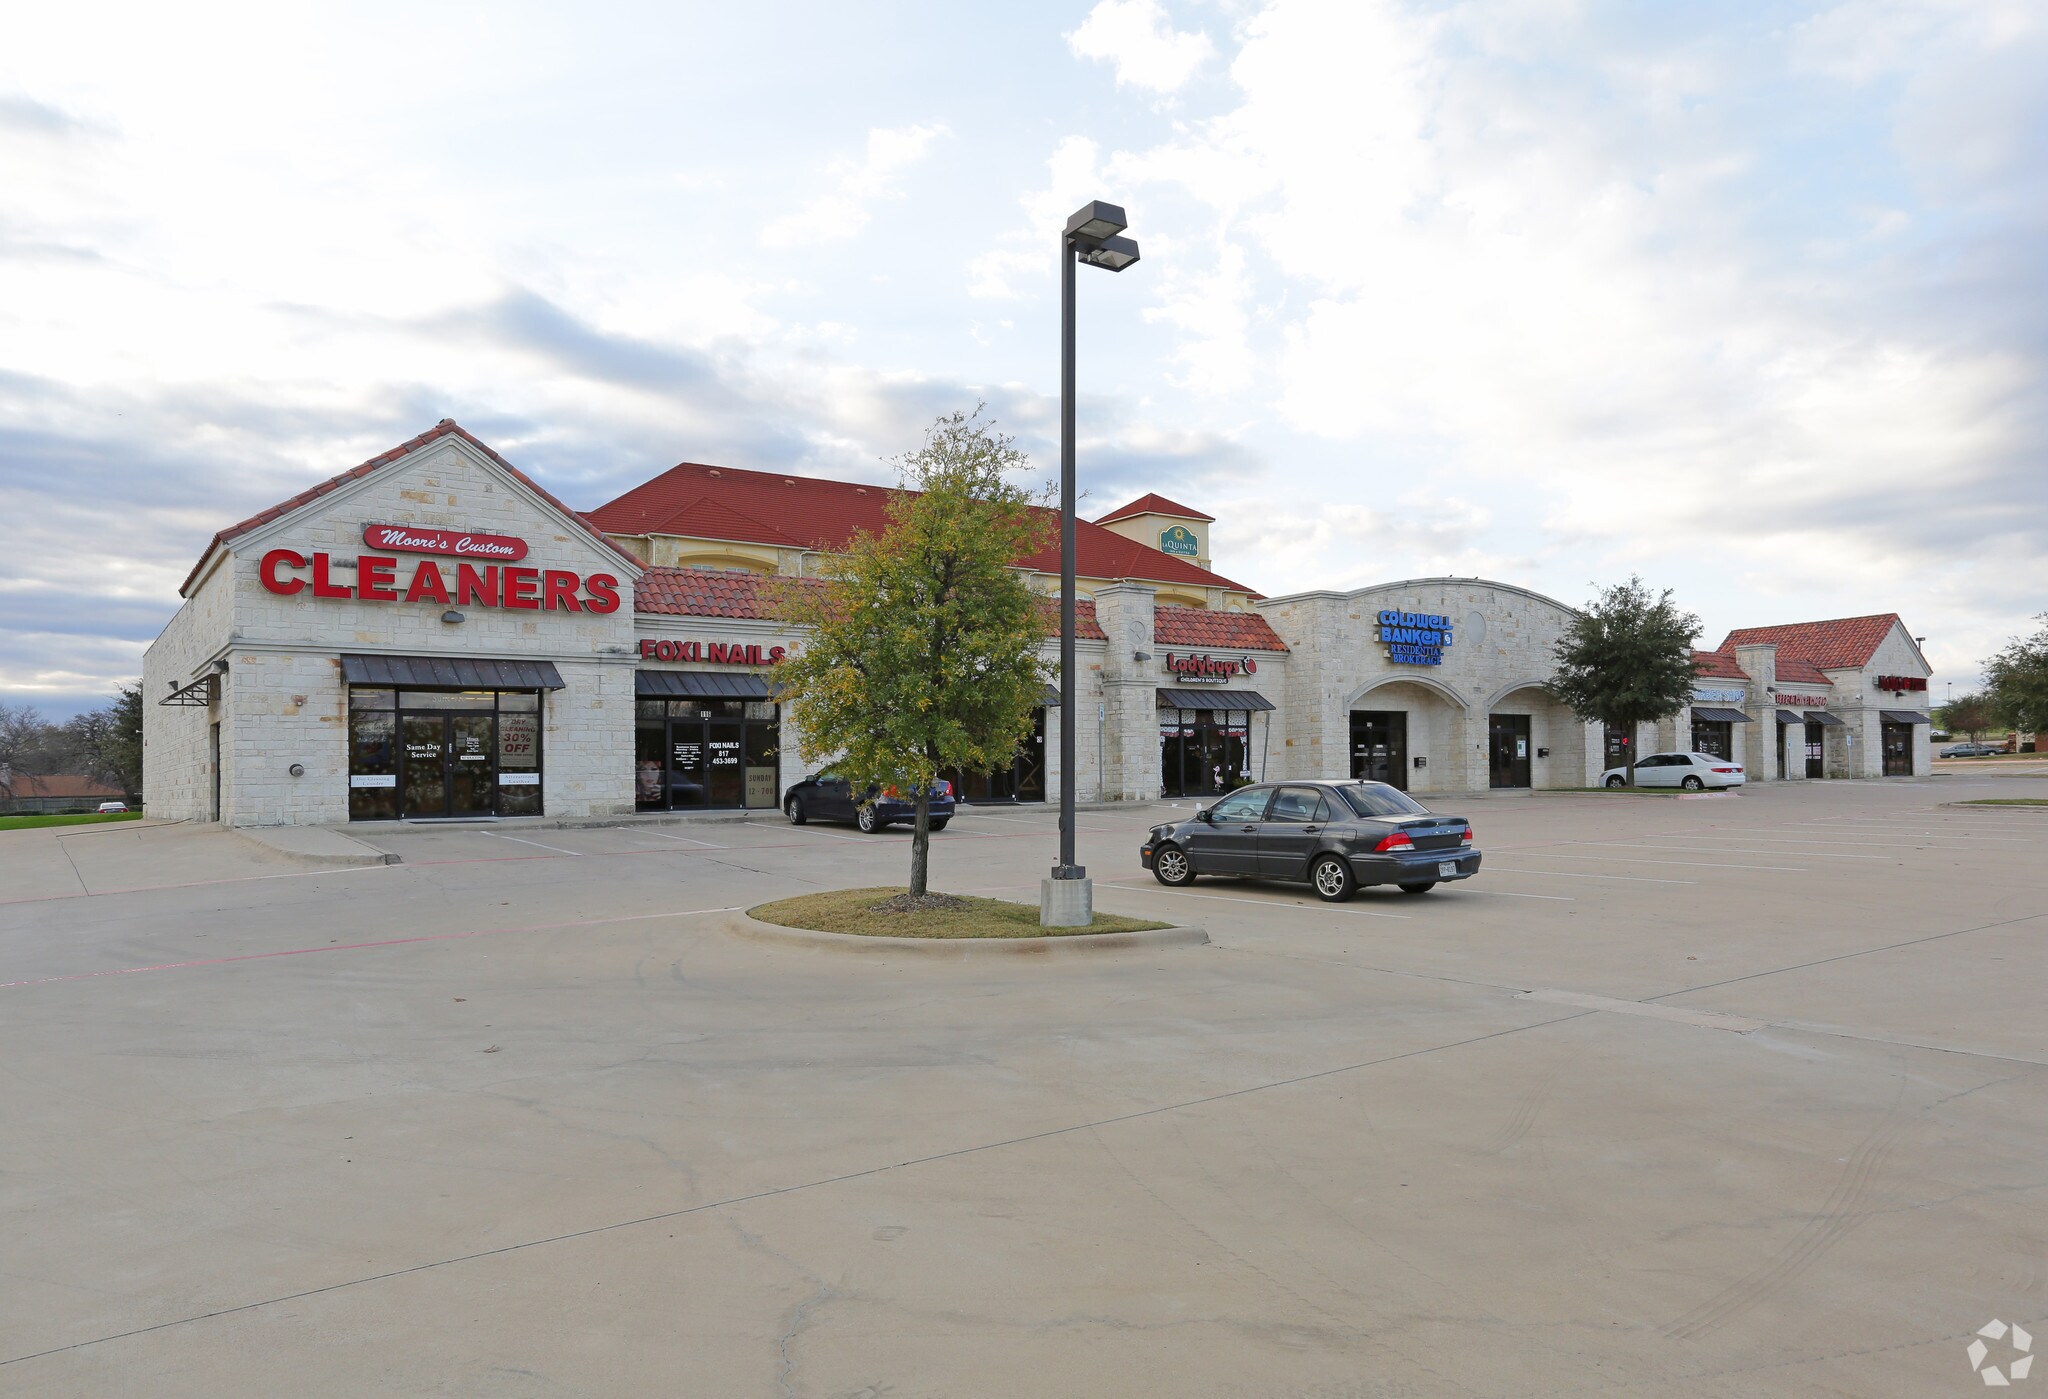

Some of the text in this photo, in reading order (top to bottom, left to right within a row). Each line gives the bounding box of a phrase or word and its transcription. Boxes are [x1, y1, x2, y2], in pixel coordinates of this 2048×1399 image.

[380, 529, 515, 555] Moore's Custom
[1167, 540, 1197, 551] QUINTA
[259, 548, 621, 614] CLEANERS
[640, 639, 786, 665] FOXI NAILS
[1391, 644, 1444, 656] RESIDENTIAL
[1166, 652, 1240, 678] Ladybugs
[1393, 654, 1441, 665] BROKERAGE
[1724, 689, 1745, 702] SHOP
[503, 733, 531, 743] 30%
[427, 743, 441, 751] Day
[505, 744, 530, 753] OFF
[748, 774, 772, 782] SUNDAY
